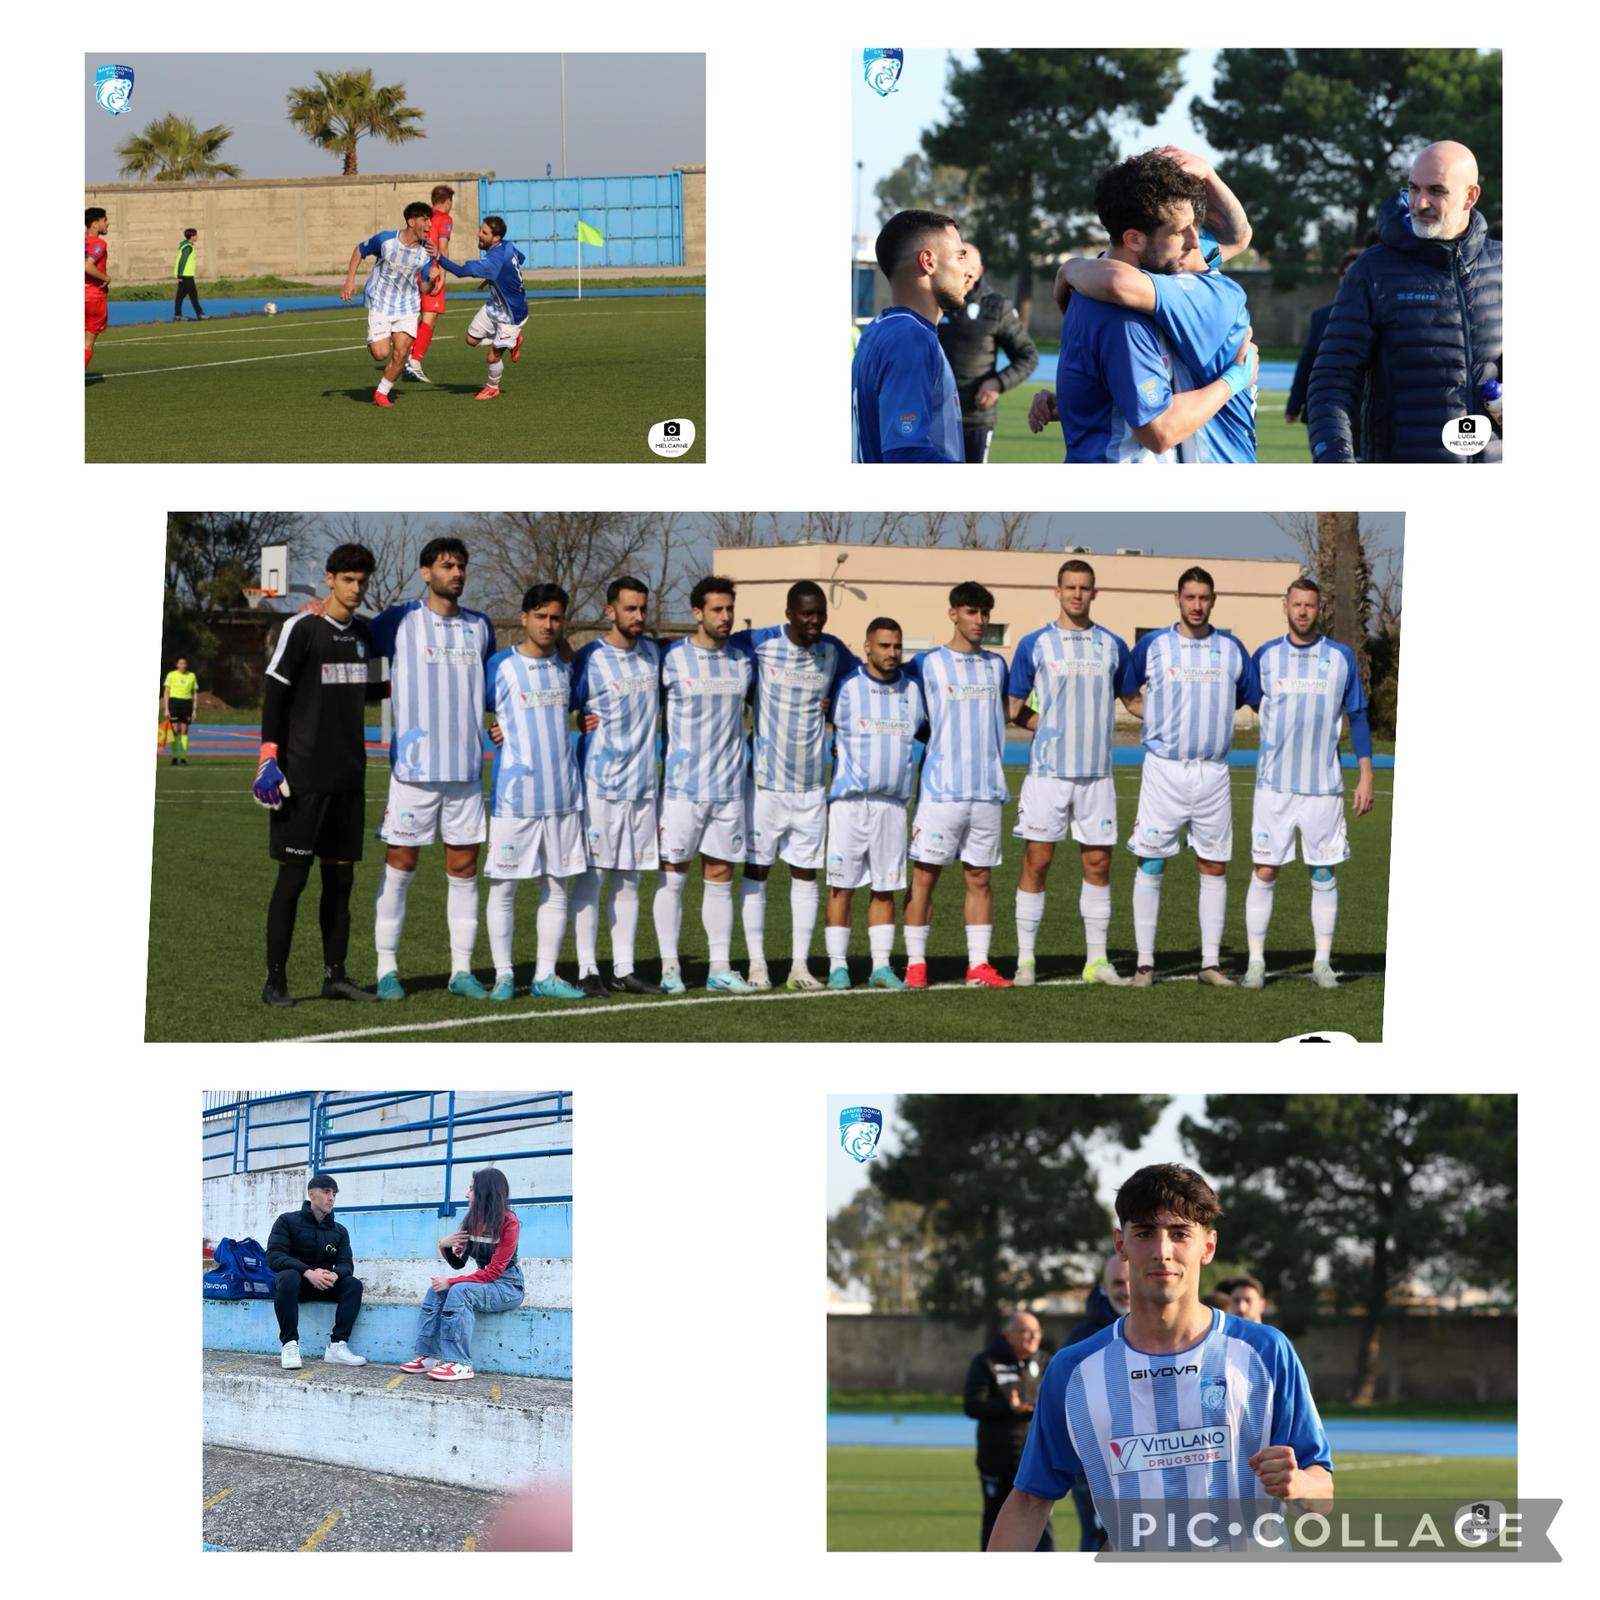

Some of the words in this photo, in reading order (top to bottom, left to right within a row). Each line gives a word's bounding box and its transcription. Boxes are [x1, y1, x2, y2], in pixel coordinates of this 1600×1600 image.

[1131, 1365, 1198, 1380] GIVOVA
[1140, 1431, 1225, 1452] VITULANO
[1148, 1451, 1221, 1468] DRUGSTORE
